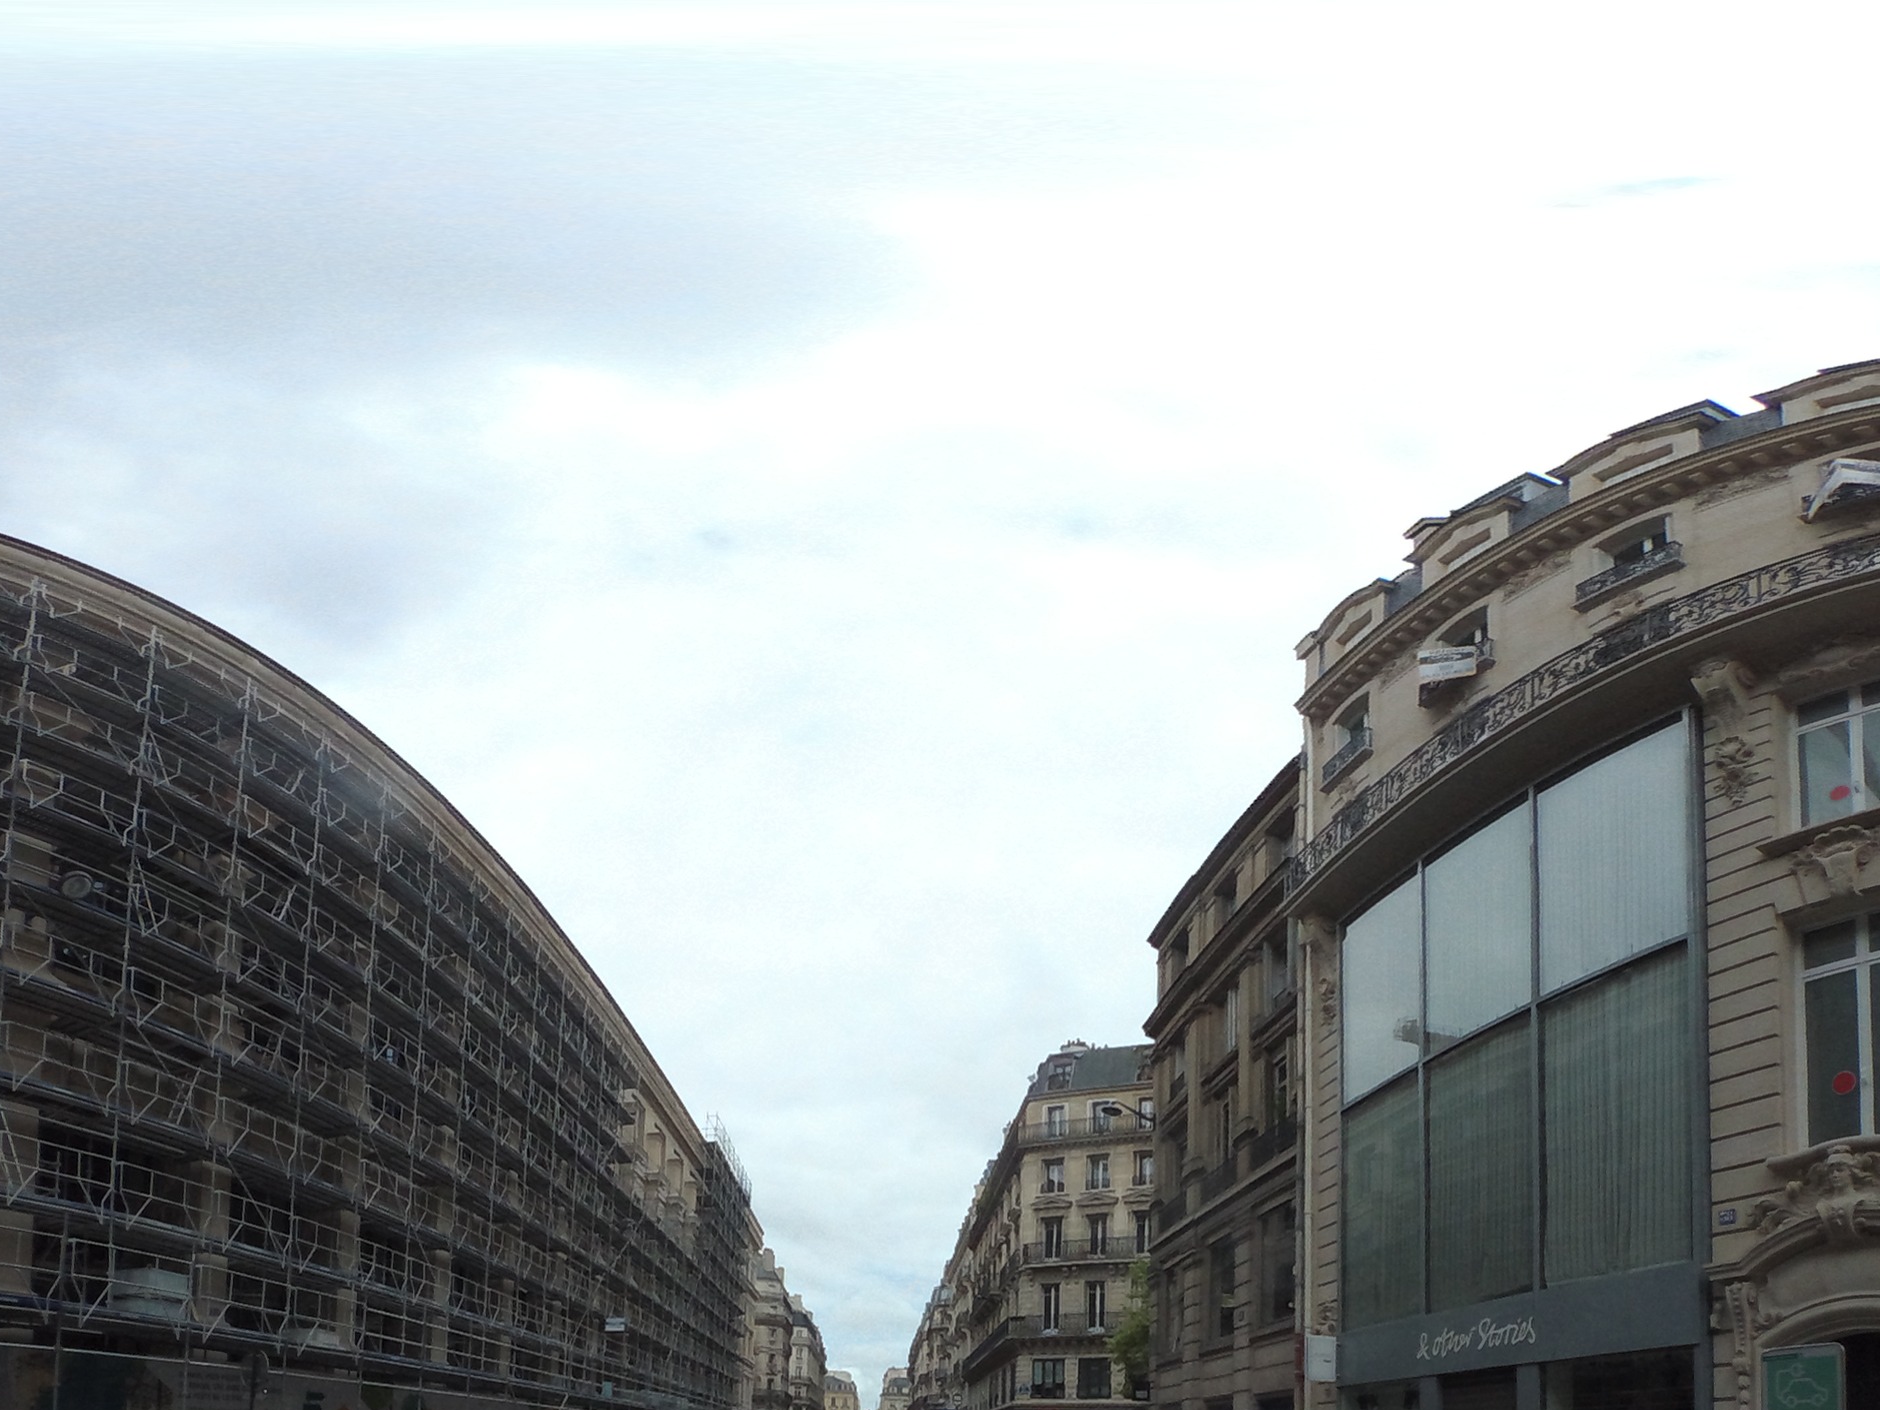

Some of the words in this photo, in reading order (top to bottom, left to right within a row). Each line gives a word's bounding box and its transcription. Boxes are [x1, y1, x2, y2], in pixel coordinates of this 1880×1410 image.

[1416, 1332, 1431, 1360] &
[1432, 1327, 1477, 1358] other
[1477, 1316, 1537, 1351] Stories
